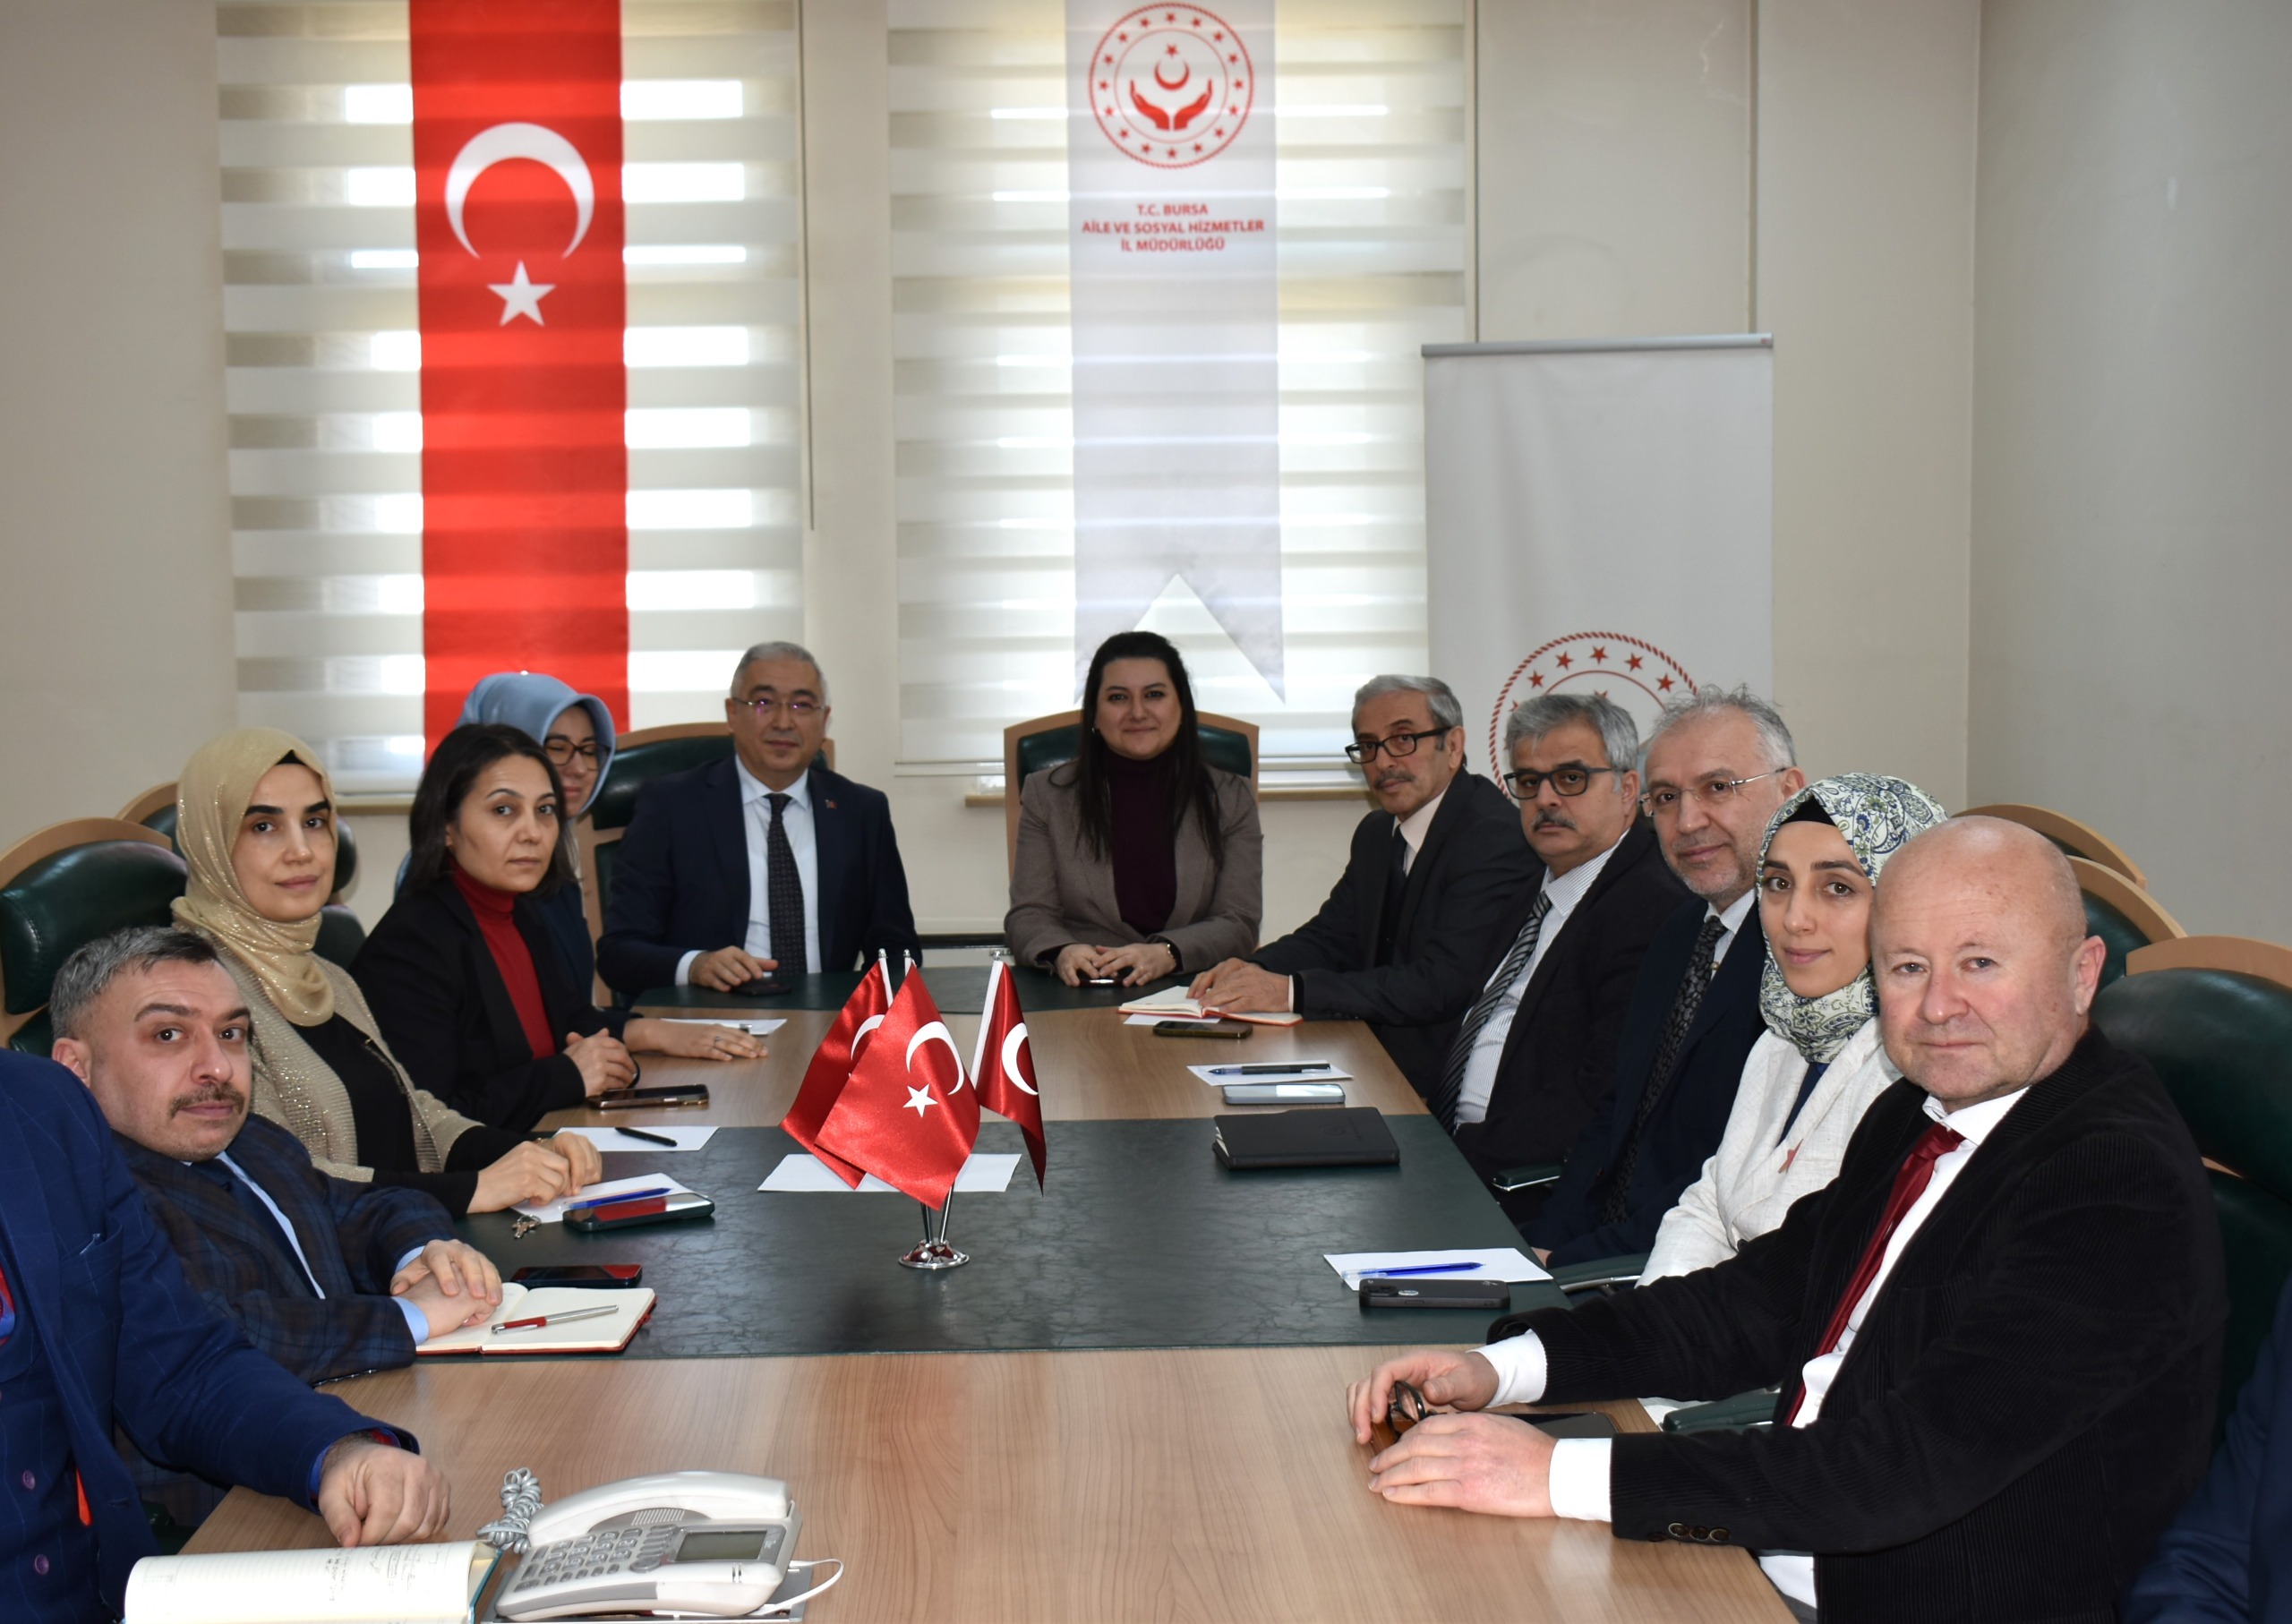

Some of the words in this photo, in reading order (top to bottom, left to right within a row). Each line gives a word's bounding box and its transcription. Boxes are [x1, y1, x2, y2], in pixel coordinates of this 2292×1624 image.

[1136, 203, 1161, 216] T.C.
[1163, 203, 1209, 216] BURSA
[1082, 219, 1112, 234] AİLE
[1113, 221, 1131, 234] VE
[1133, 221, 1185, 235] SOSYAL
[1188, 218, 1265, 234] HİZMETLER
[1120, 237, 1133, 252] İL
[1135, 236, 1226, 252] MÜDÜRLÜĞÜ
